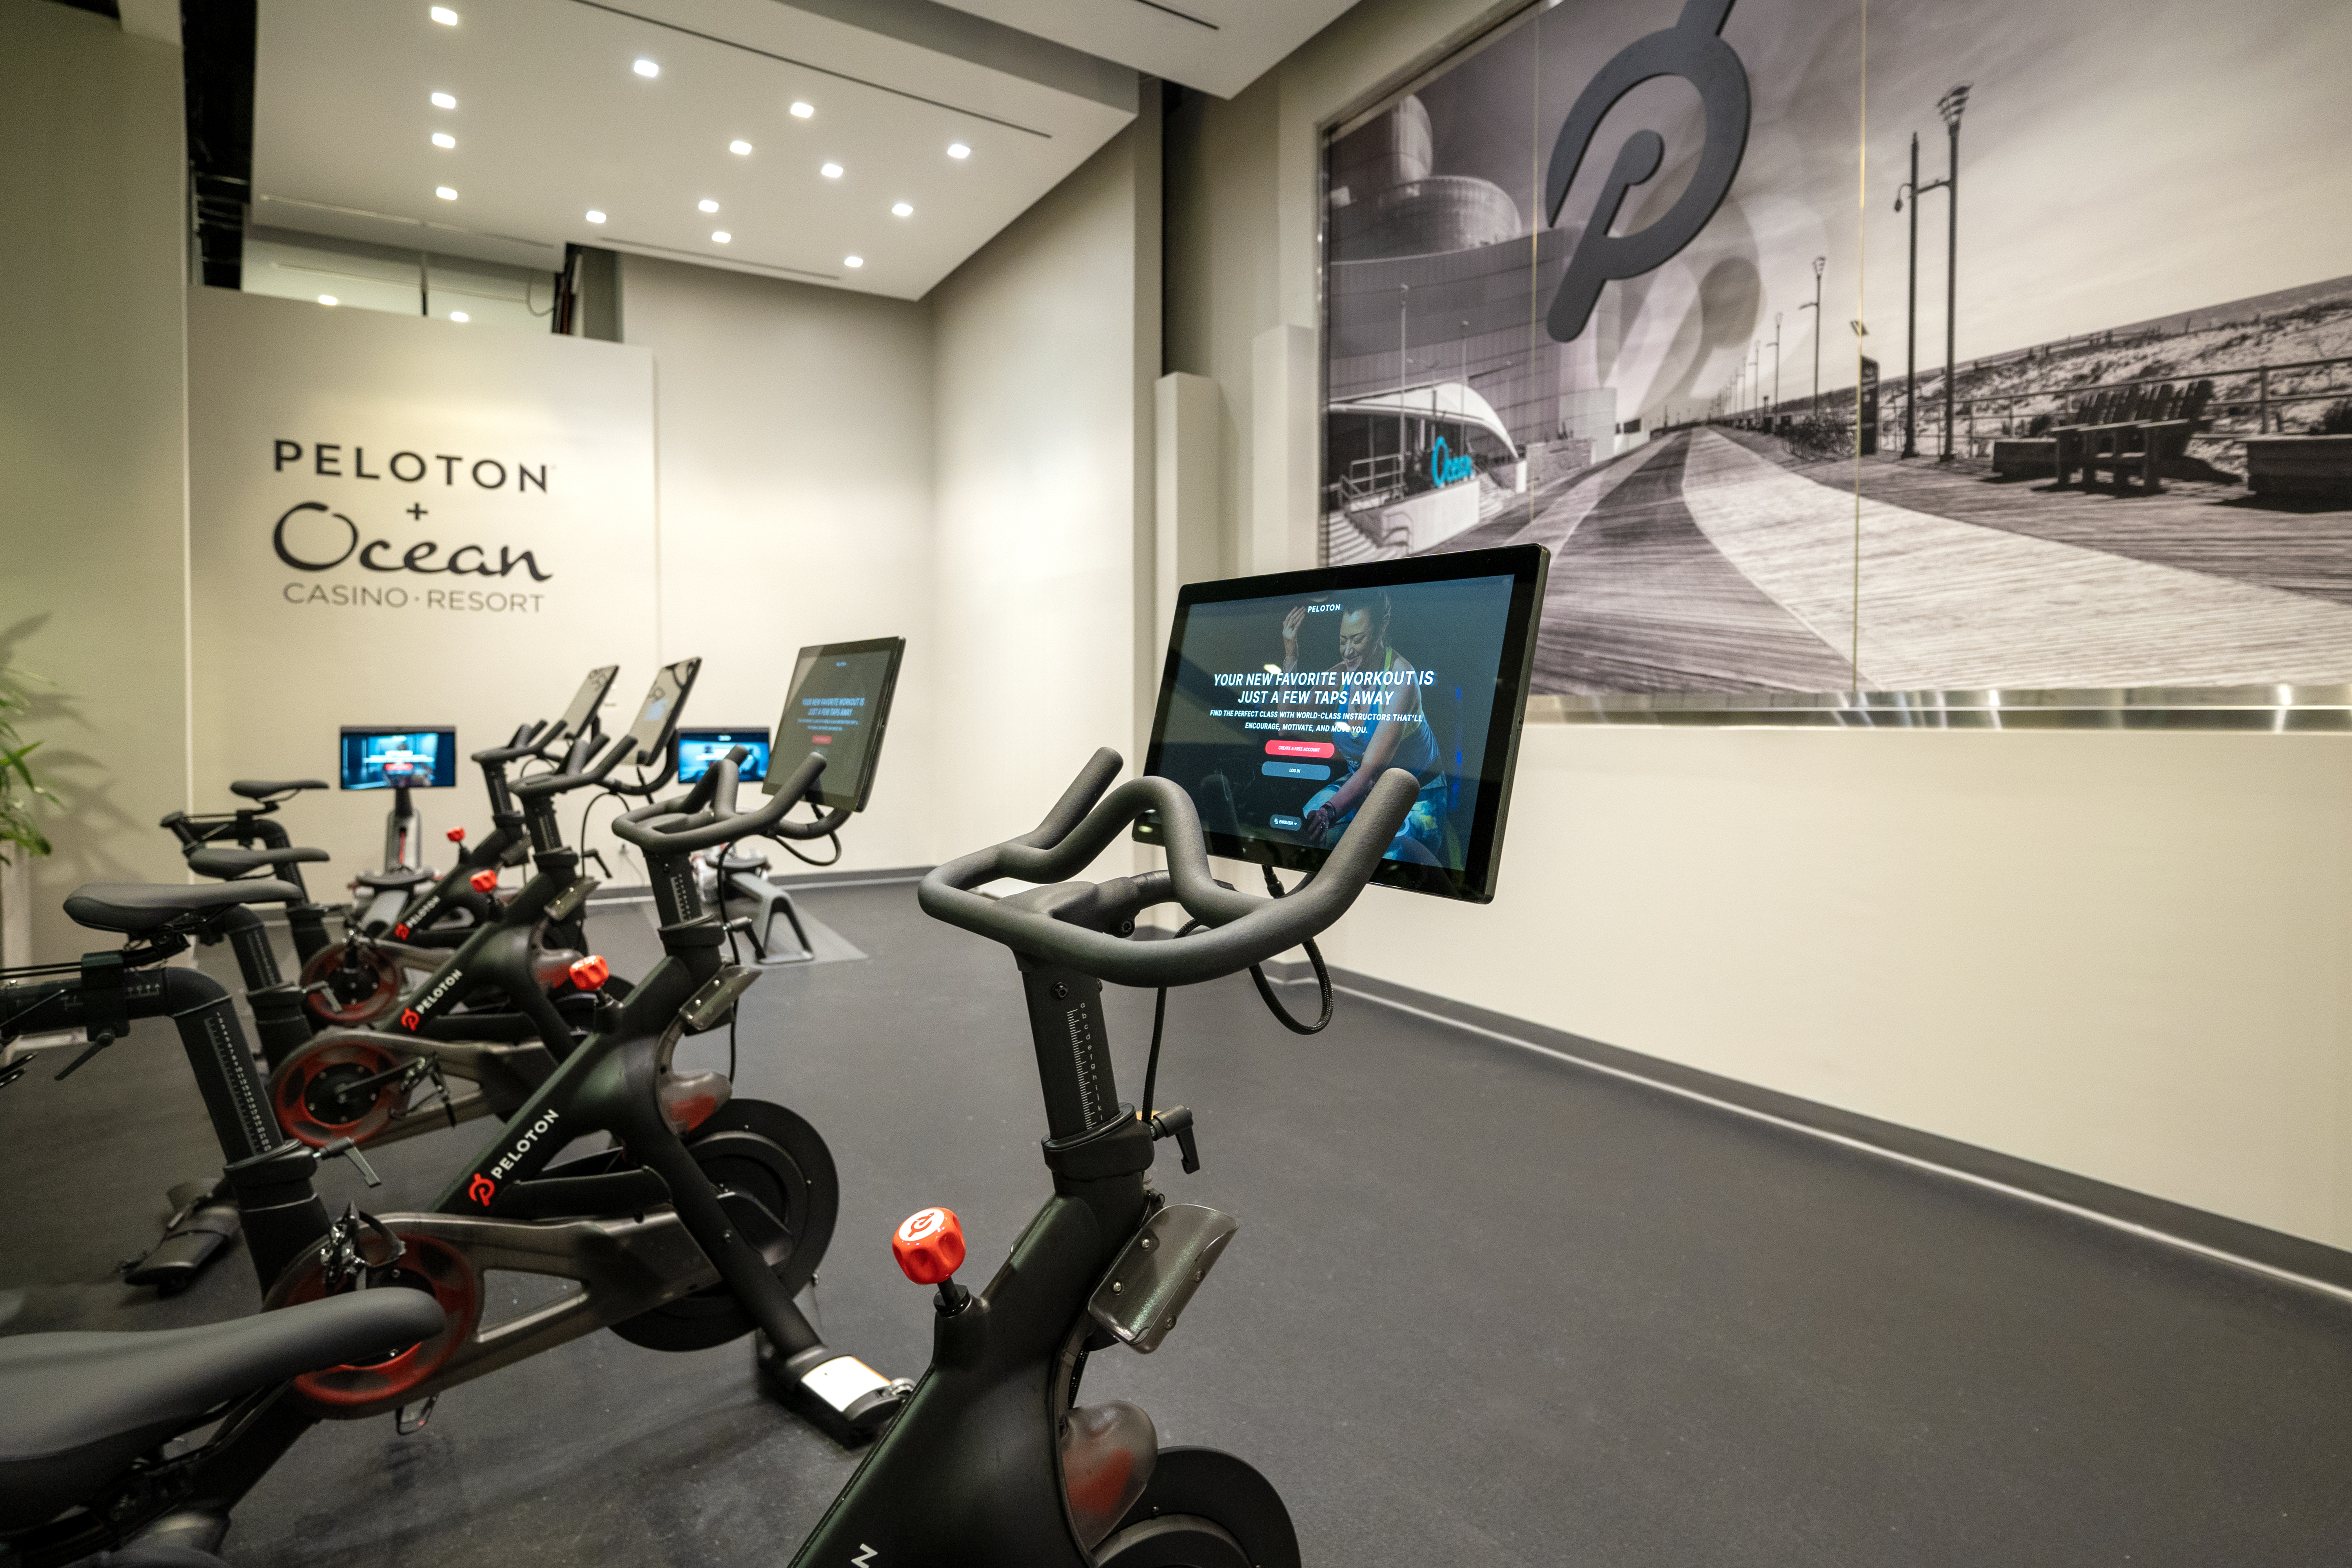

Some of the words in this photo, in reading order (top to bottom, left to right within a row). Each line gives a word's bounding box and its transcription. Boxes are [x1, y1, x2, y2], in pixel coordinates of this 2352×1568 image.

[274, 439, 548, 493] PELOTON
[272, 501, 554, 582] Ocean
[283, 583, 409, 608] CASINO
[427, 590, 545, 613] RESORT
[1307, 604, 1341, 613] PELOTON
[1214, 674, 1243, 686] YOUR
[1246, 673, 1273, 686] NEW
[1276, 672, 1337, 685] FAVORITE
[1341, 671, 1415, 685] WORKOUT
[1419, 670, 1434, 685] IS
[1238, 691, 1268, 703] JUST
[1270, 691, 1279, 703] A
[1283, 691, 1310, 704] FEW
[1314, 691, 1348, 704] TAPS
[1351, 691, 1394, 705] AWAY
[1245, 722, 1281, 731] ENCOURAGE,
[1282, 724, 1314, 732] MOTIVATE,
[416, 969, 463, 1014] PELOTON
[491, 1109, 559, 1179] PELOTON
